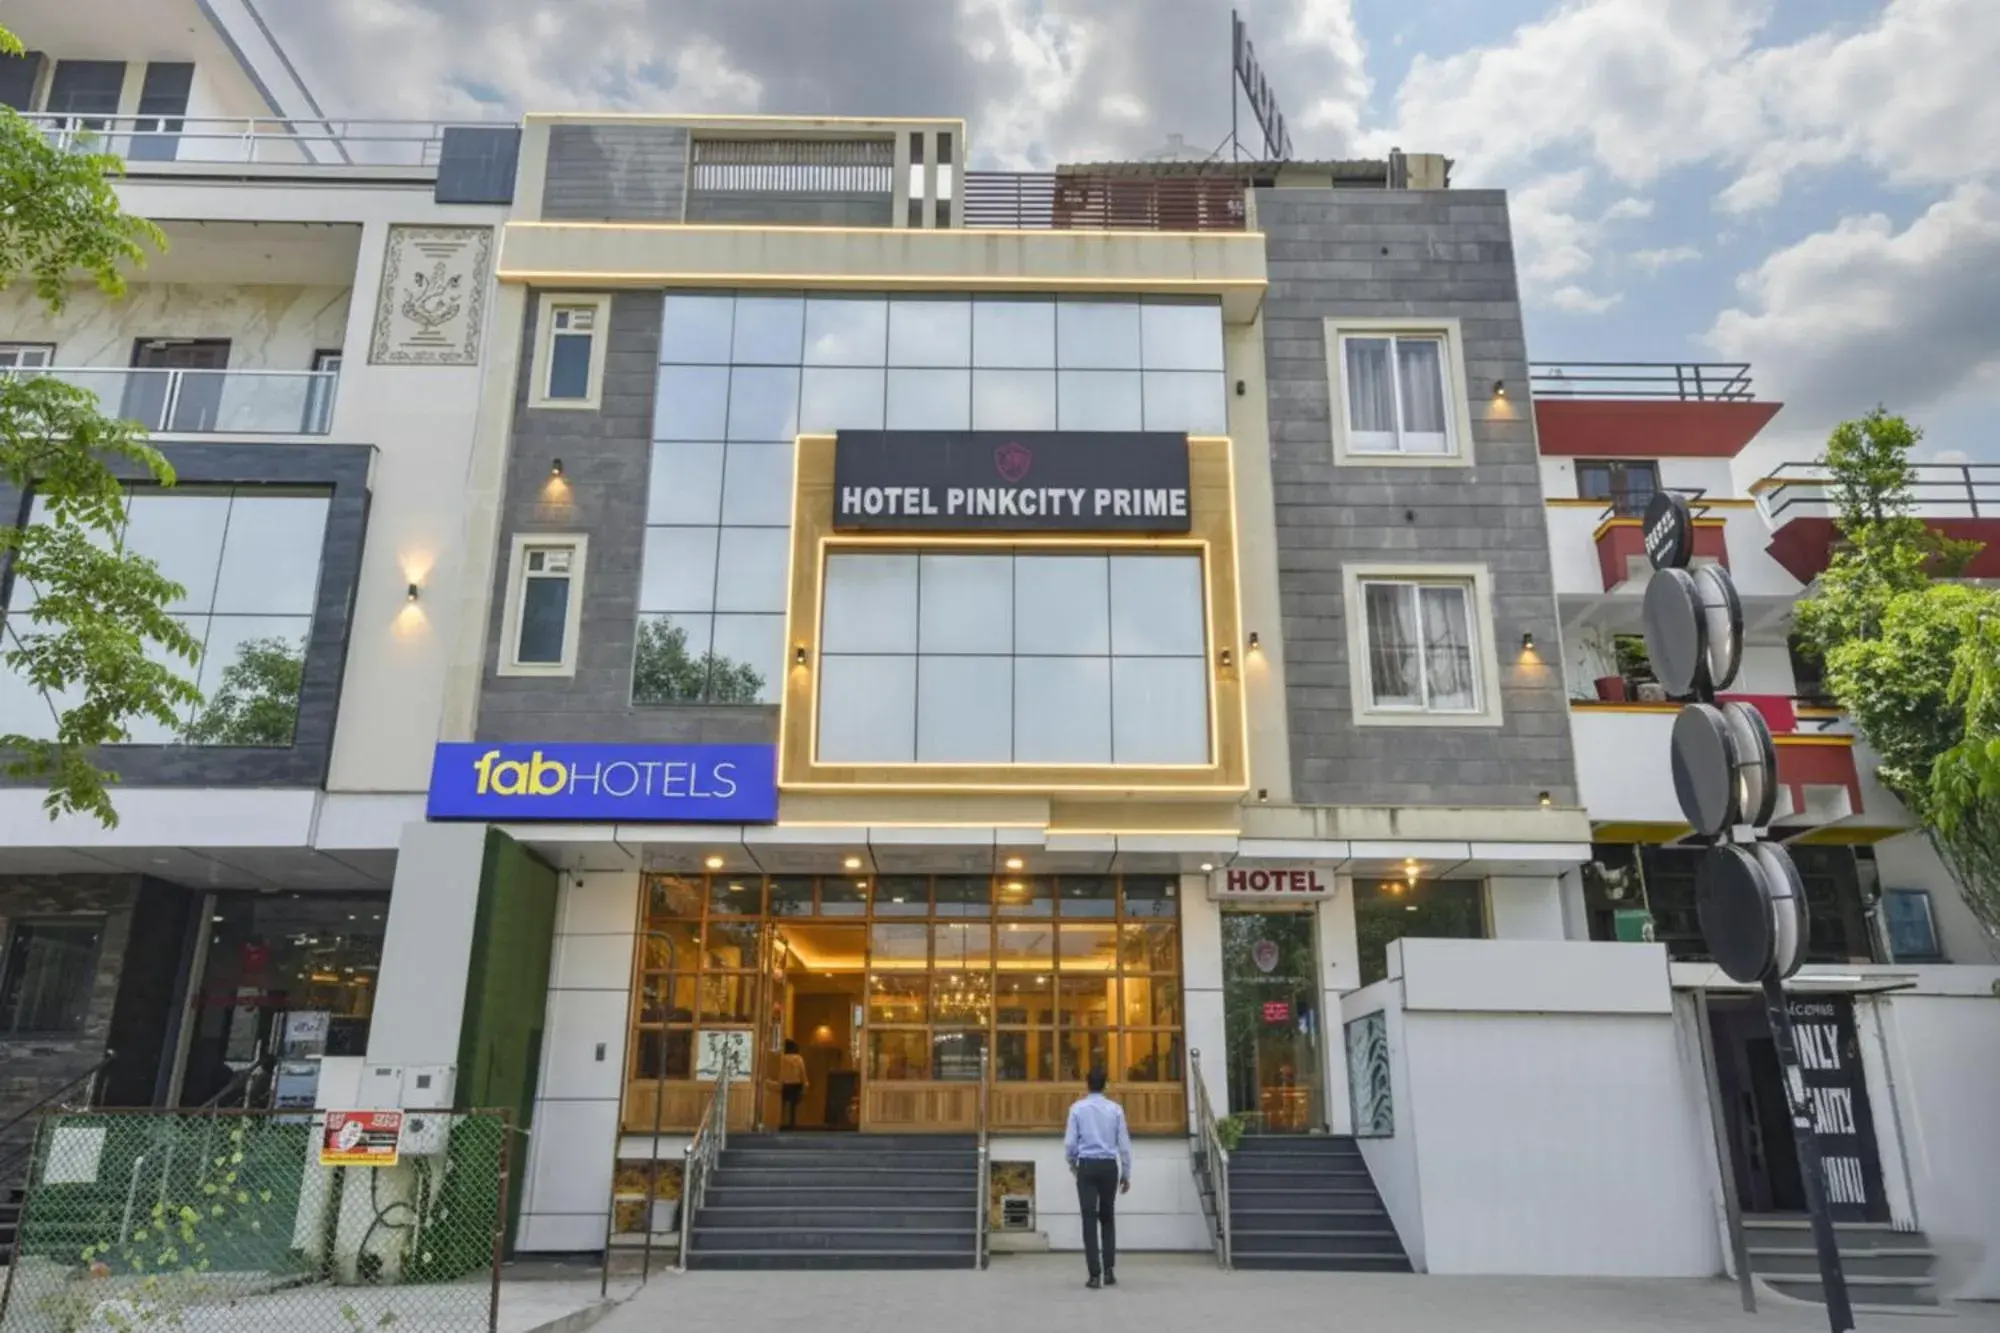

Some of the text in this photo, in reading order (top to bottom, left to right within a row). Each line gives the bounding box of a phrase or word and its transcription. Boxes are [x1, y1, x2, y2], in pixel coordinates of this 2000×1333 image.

[841, 487, 1187, 516] HOTEL PINKCITY PRIME
[1226, 869, 1325, 892] HOTEL
